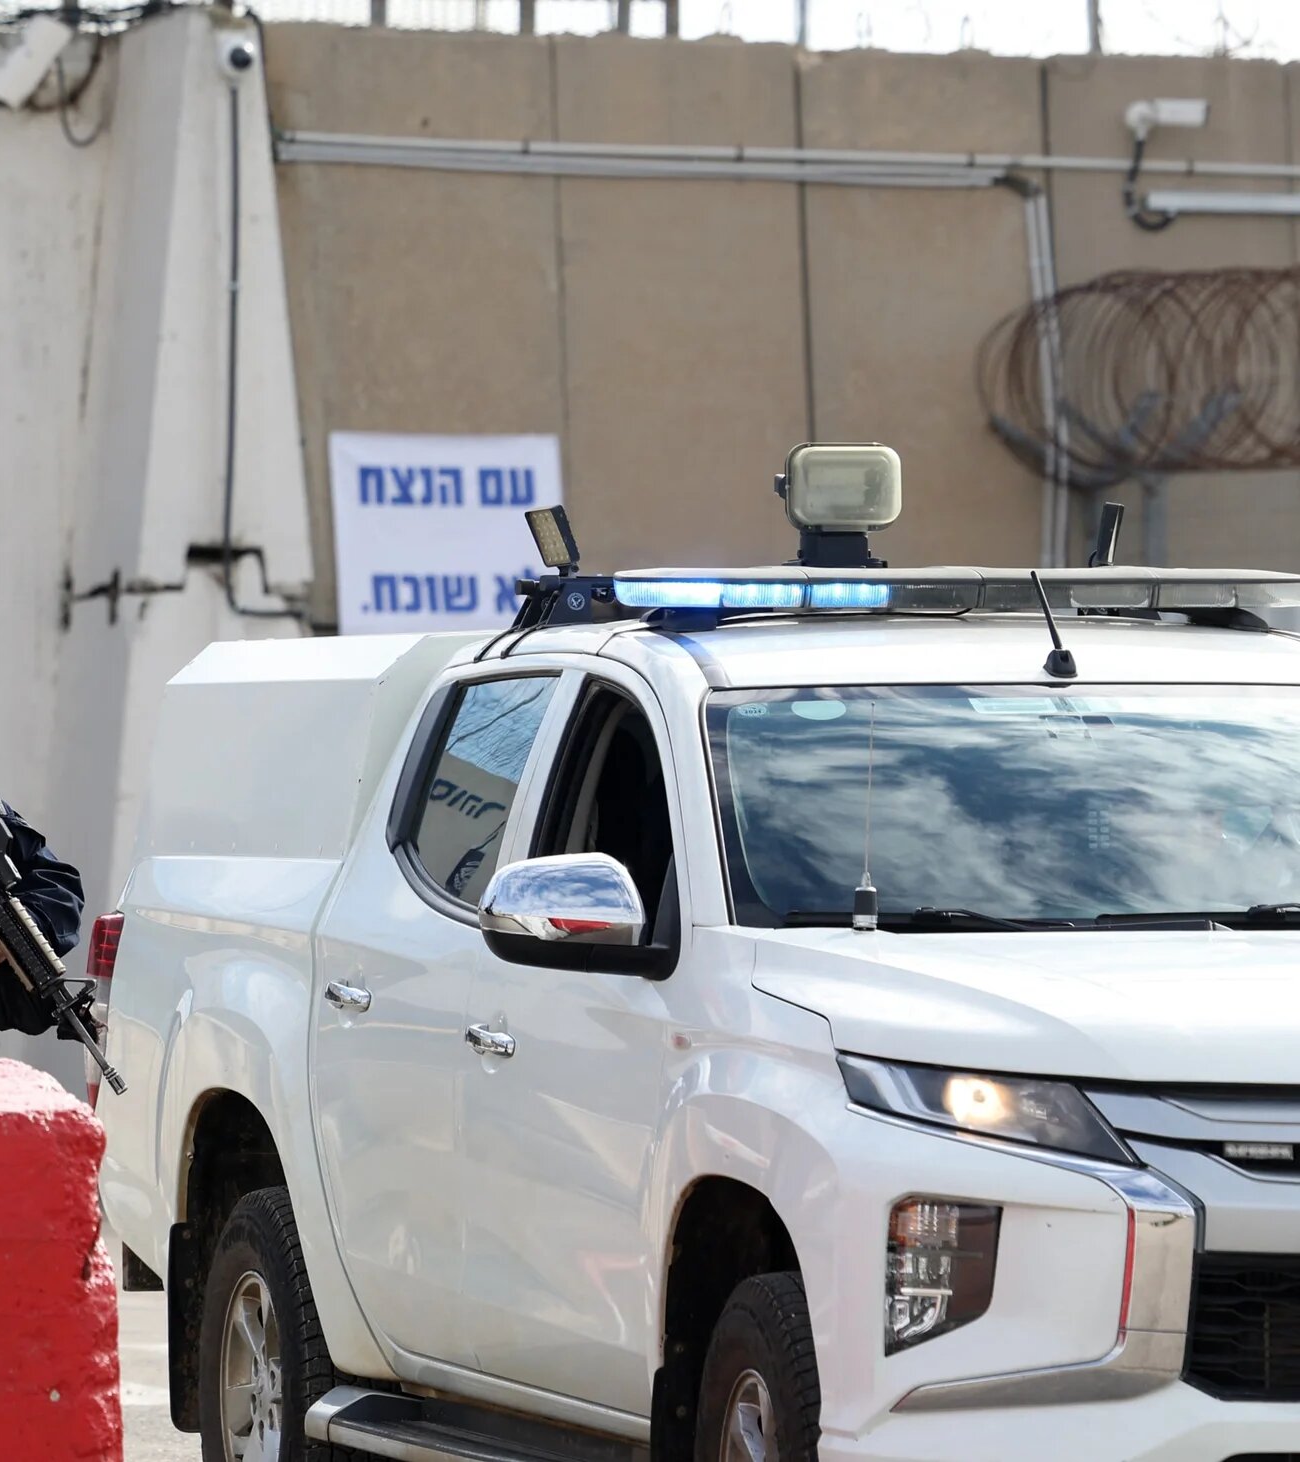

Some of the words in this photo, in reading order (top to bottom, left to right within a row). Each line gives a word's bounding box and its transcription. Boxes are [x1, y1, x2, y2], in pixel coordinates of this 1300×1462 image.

[358, 466, 464, 506] הנצח
[478, 467, 536, 506] עם
[361, 573, 479, 614] שוכח.
